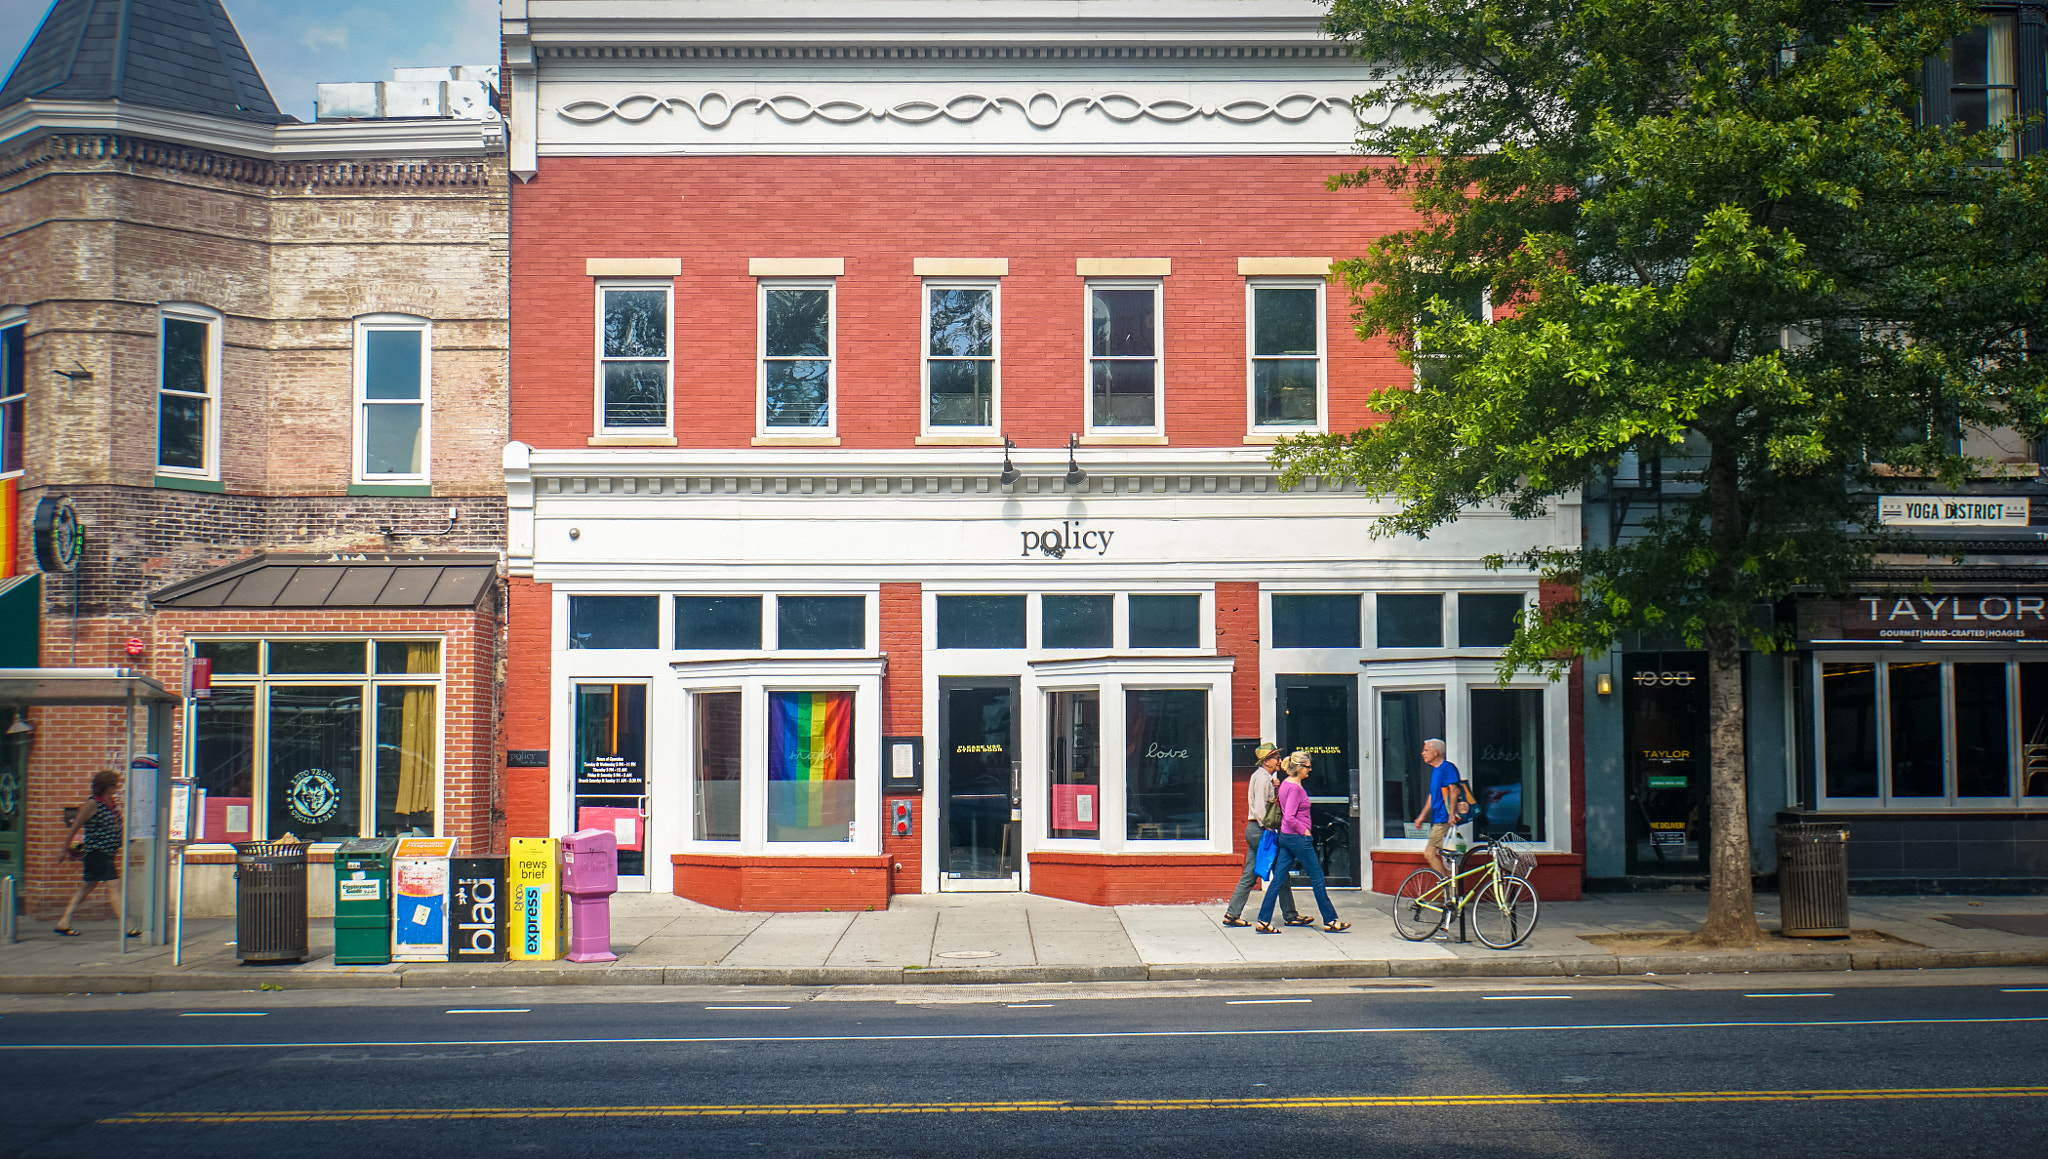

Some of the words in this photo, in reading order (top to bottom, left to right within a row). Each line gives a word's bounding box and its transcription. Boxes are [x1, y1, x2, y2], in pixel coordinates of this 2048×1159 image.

[1906, 503, 1939, 519] YOGA
[1945, 503, 2003, 520] DISTRICT
[1021, 521, 1115, 558] policy
[1859, 596, 2046, 621] TAYLOR
[511, 751, 536, 762] policy
[1145, 742, 1189, 759] love
[1643, 750, 1690, 758] TAYLOR
[519, 861, 548, 869] news
[521, 869, 546, 879] brief
[527, 889, 538, 953] express
